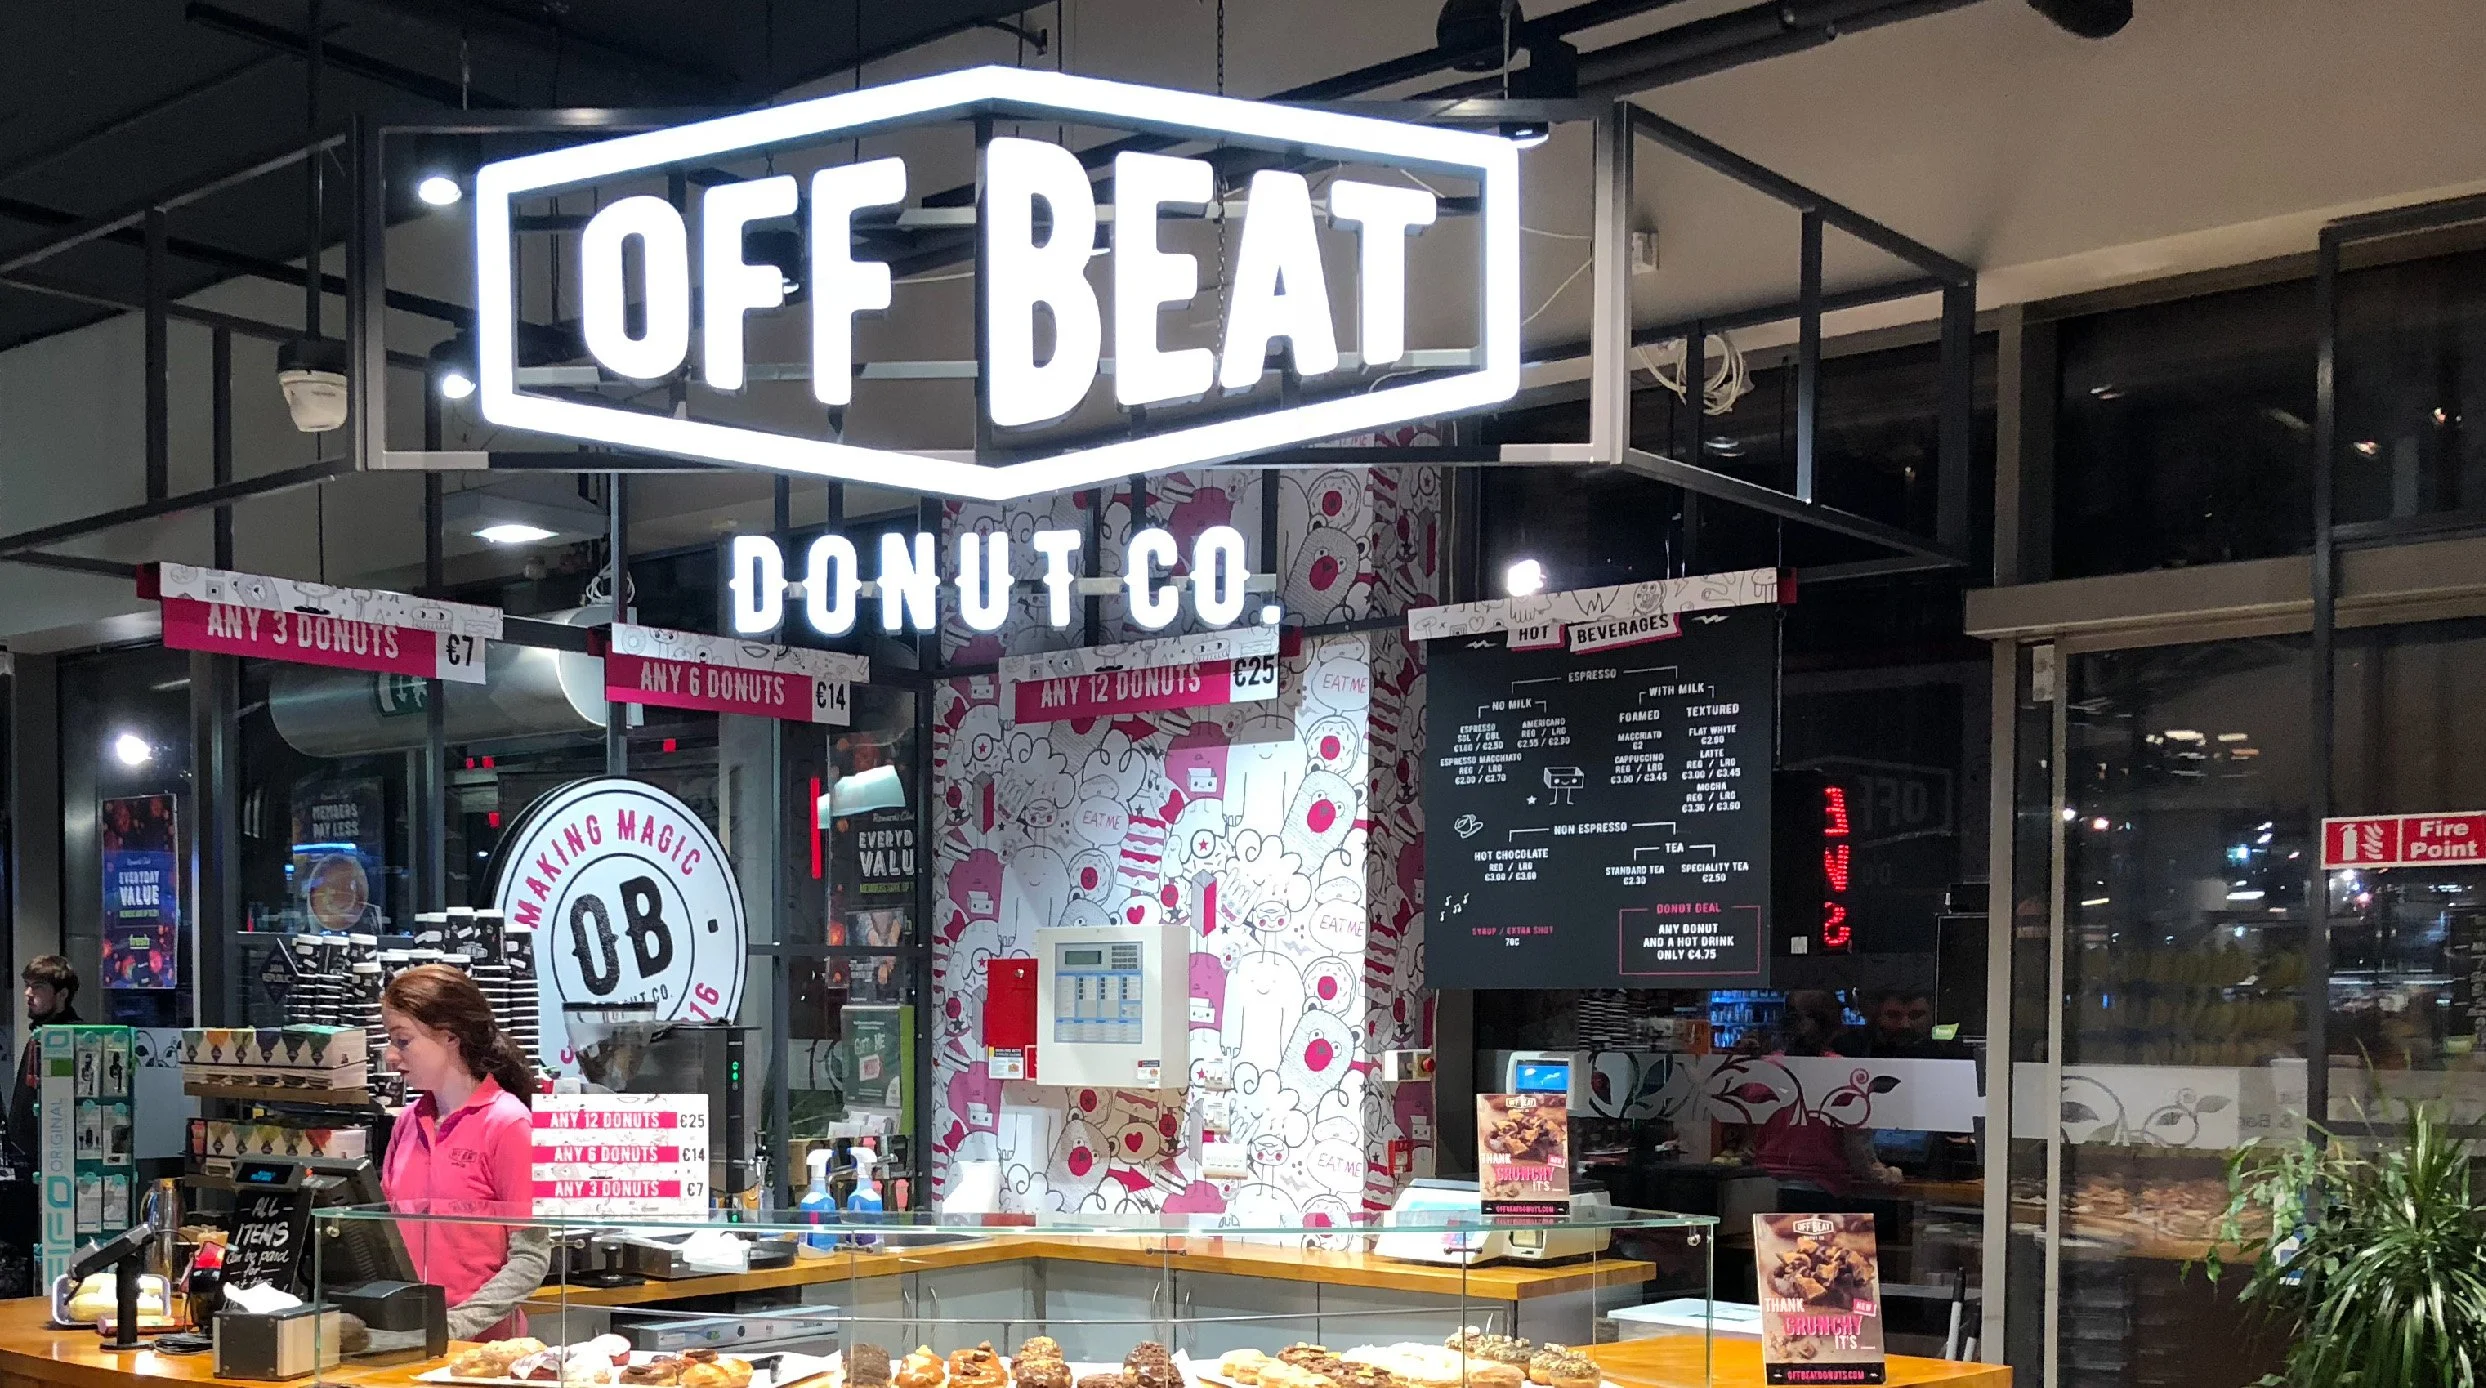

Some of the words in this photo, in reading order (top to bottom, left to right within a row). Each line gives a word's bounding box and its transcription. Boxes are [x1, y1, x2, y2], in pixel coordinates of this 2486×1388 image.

[582, 156, 907, 405] OFF
[987, 136, 1437, 427] BEAT
[730, 530, 1082, 635] DONUT
[1123, 526, 1281, 629] CO.
[207, 603, 261, 642] ANY
[272, 613, 288, 645] 3
[297, 614, 400, 659] DONUTS
[1519, 625, 1549, 641] HOT
[1577, 614, 1669, 644] BEVERAGES
[446, 633, 474, 667] €7
[1233, 656, 1275, 688] €25
[1568, 669, 1617, 683] ESPRESSO
[641, 661, 683, 694] ANY
[689, 669, 700, 697] 6
[708, 669, 785, 706] DONUTS
[1040, 681, 1080, 709] ANY
[1089, 677, 1108, 703] 12
[1116, 664, 1201, 702] DONUTS
[1322, 673, 1351, 692] EAT
[1350, 677, 1369, 694] ME
[1649, 684, 1675, 697] WITH
[1678, 682, 1705, 695] MILK
[816, 680, 847, 711] €14
[1492, 701, 1505, 711] NO
[1508, 698, 1532, 710] MILK
[1686, 703, 1739, 718] TEXTURED
[1522, 718, 1566, 729] AMERICANO
[1619, 710, 1660, 723] FOAMED
[1460, 723, 1496, 734] ESPRESSO
[1688, 727, 1707, 737] FLAT
[1710, 724, 1737, 734] WHITE
[1617, 731, 1662, 742] MACCHIATO
[1614, 754, 1664, 764] CAPPUCCINO
[1700, 749, 1724, 758] LATTE
[1696, 781, 1727, 791] MOCHA
[1082, 810, 1106, 827] EAT
[1105, 815, 1123, 831] ME
[1554, 825, 1575, 836] NON
[1578, 822, 1627, 835] ESPRESSO
[2420, 820, 2469, 837] Fire
[858, 829, 914, 849] EVERYD
[1474, 850, 1493, 861] HOT
[1495, 848, 1549, 860] CHOCOLATE
[1665, 842, 1684, 854] TEA
[2410, 840, 2478, 858] Point
[514, 814, 602, 930] MAKING
[617, 808, 701, 876] MAGIC
[859, 848, 915, 877] VALU
[1681, 862, 1730, 873] SPECIALITY
[1732, 861, 1749, 872] TEA
[1605, 866, 1647, 876] STANDARD
[1649, 865, 1665, 875] TEA
[119, 884, 160, 907] VALUE
[1656, 903, 1692, 914] DONUT
[1695, 902, 1722, 914] DEAL
[1319, 914, 1347, 933] EAT
[1347, 920, 1366, 937] ME
[1658, 923, 1680, 934] ANY
[1682, 923, 1719, 934] DONUT
[569, 875, 674, 997] OB
[1643, 937, 1664, 948] AND
[1667, 937, 1675, 947] A
[1677, 936, 1698, 947] HOT
[1701, 935, 1735, 947] DRINK
[1657, 949, 1685, 961] ONLY
[1687, 948, 1717, 960] €4.75
[550, 1112, 579, 1128] ANY
[584, 1112, 599, 1128] 12
[602, 1111, 660, 1129] DONUTS
[680, 1114, 705, 1128] €25
[50, 1097, 63, 1173] ORIGINAL
[554, 1147, 587, 1162] ANY
[588, 1147, 597, 1162] 6
[601, 1147, 659, 1162] DONUTS
[682, 1147, 705, 1162] €14
[1480, 1153, 1512, 1164] THANK
[1318, 1152, 1344, 1172] EAT
[1344, 1161, 1363, 1177] ME
[1495, 1166, 1554, 1182] CRUNCHY
[555, 1181, 586, 1197] ANY
[589, 1181, 597, 1196] 3
[602, 1181, 660, 1197] DONUTS
[687, 1182, 704, 1197] €7
[1532, 1181, 1550, 1192] IT'S
[251, 1196, 279, 1219] ALL
[235, 1221, 289, 1247] ITEMS
[1765, 1298, 1806, 1313] THANK
[1856, 1301, 1873, 1311] NEW
[1784, 1315, 1863, 1336] CRUNCHY
[1834, 1335, 1857, 1350] IT'S
